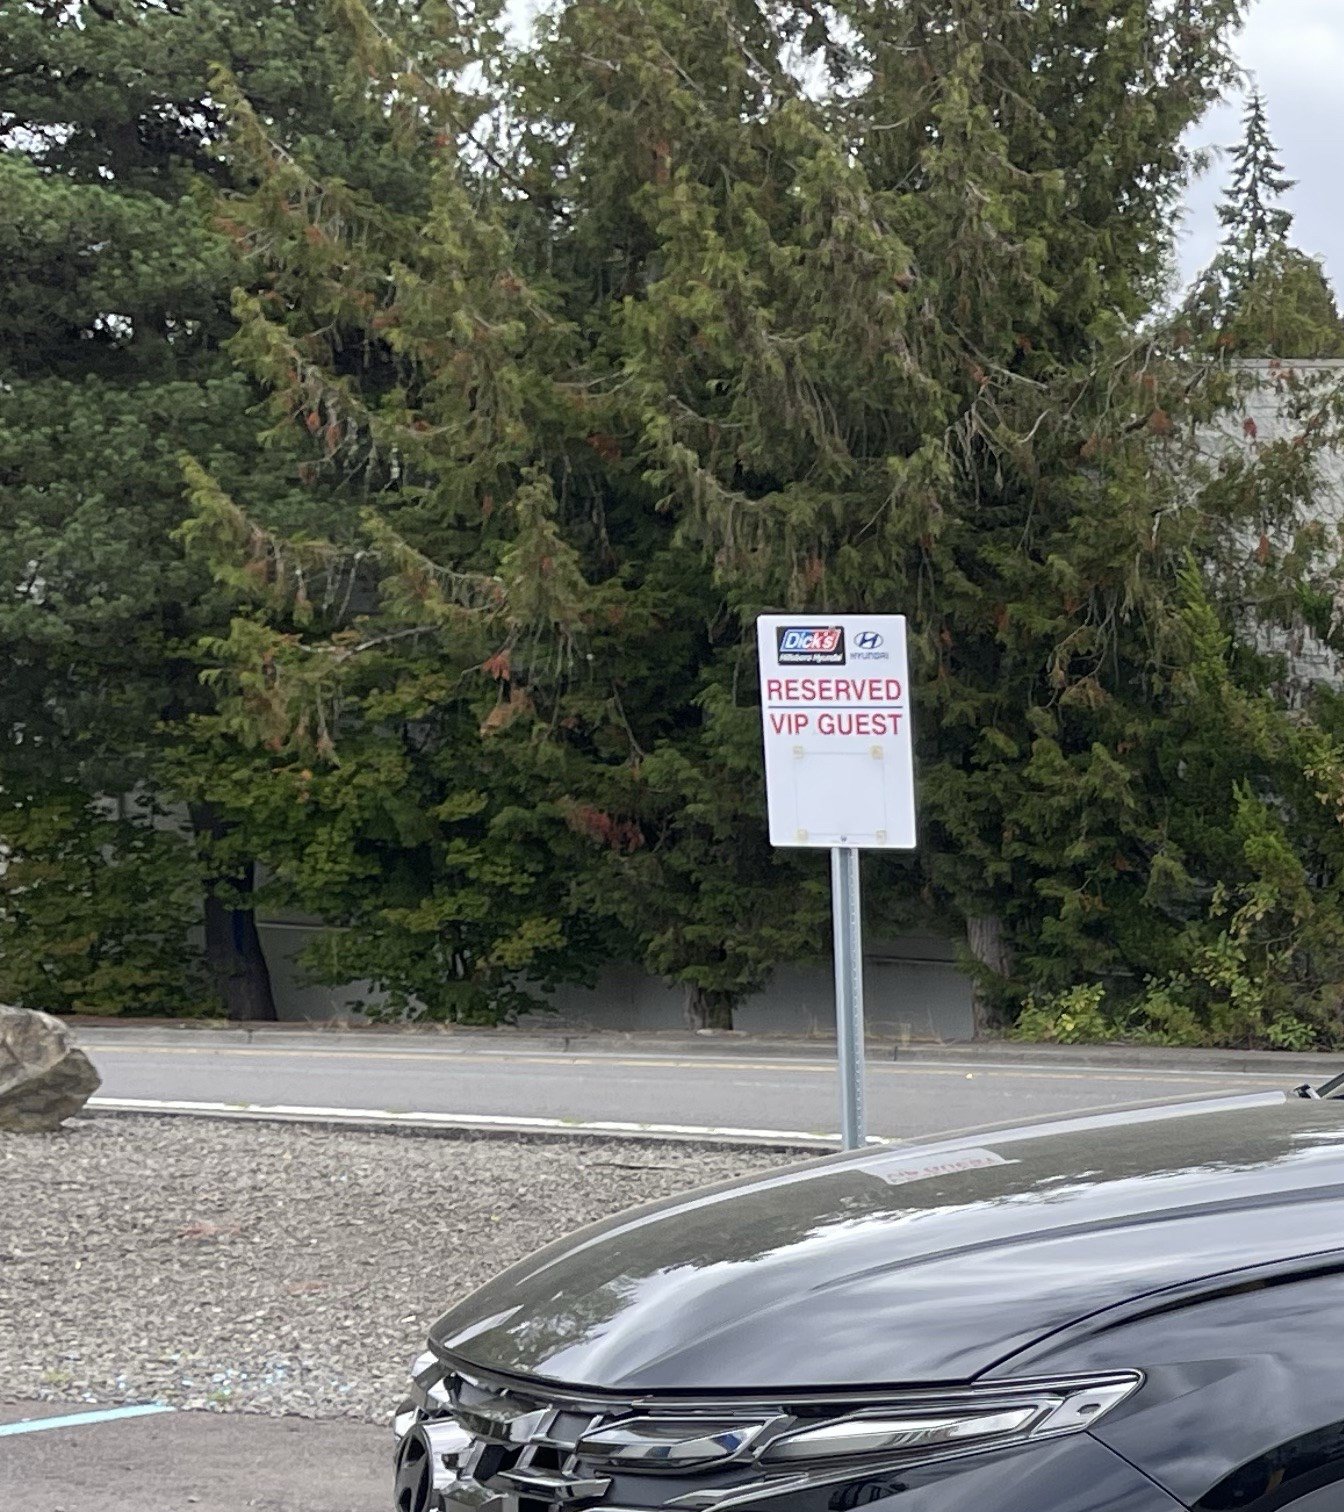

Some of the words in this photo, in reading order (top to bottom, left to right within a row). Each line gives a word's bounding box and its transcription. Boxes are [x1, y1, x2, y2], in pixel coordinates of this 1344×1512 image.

[767, 679, 902, 701] RESERVED
[770, 713, 809, 735] VIP
[818, 713, 903, 735] GUEST
